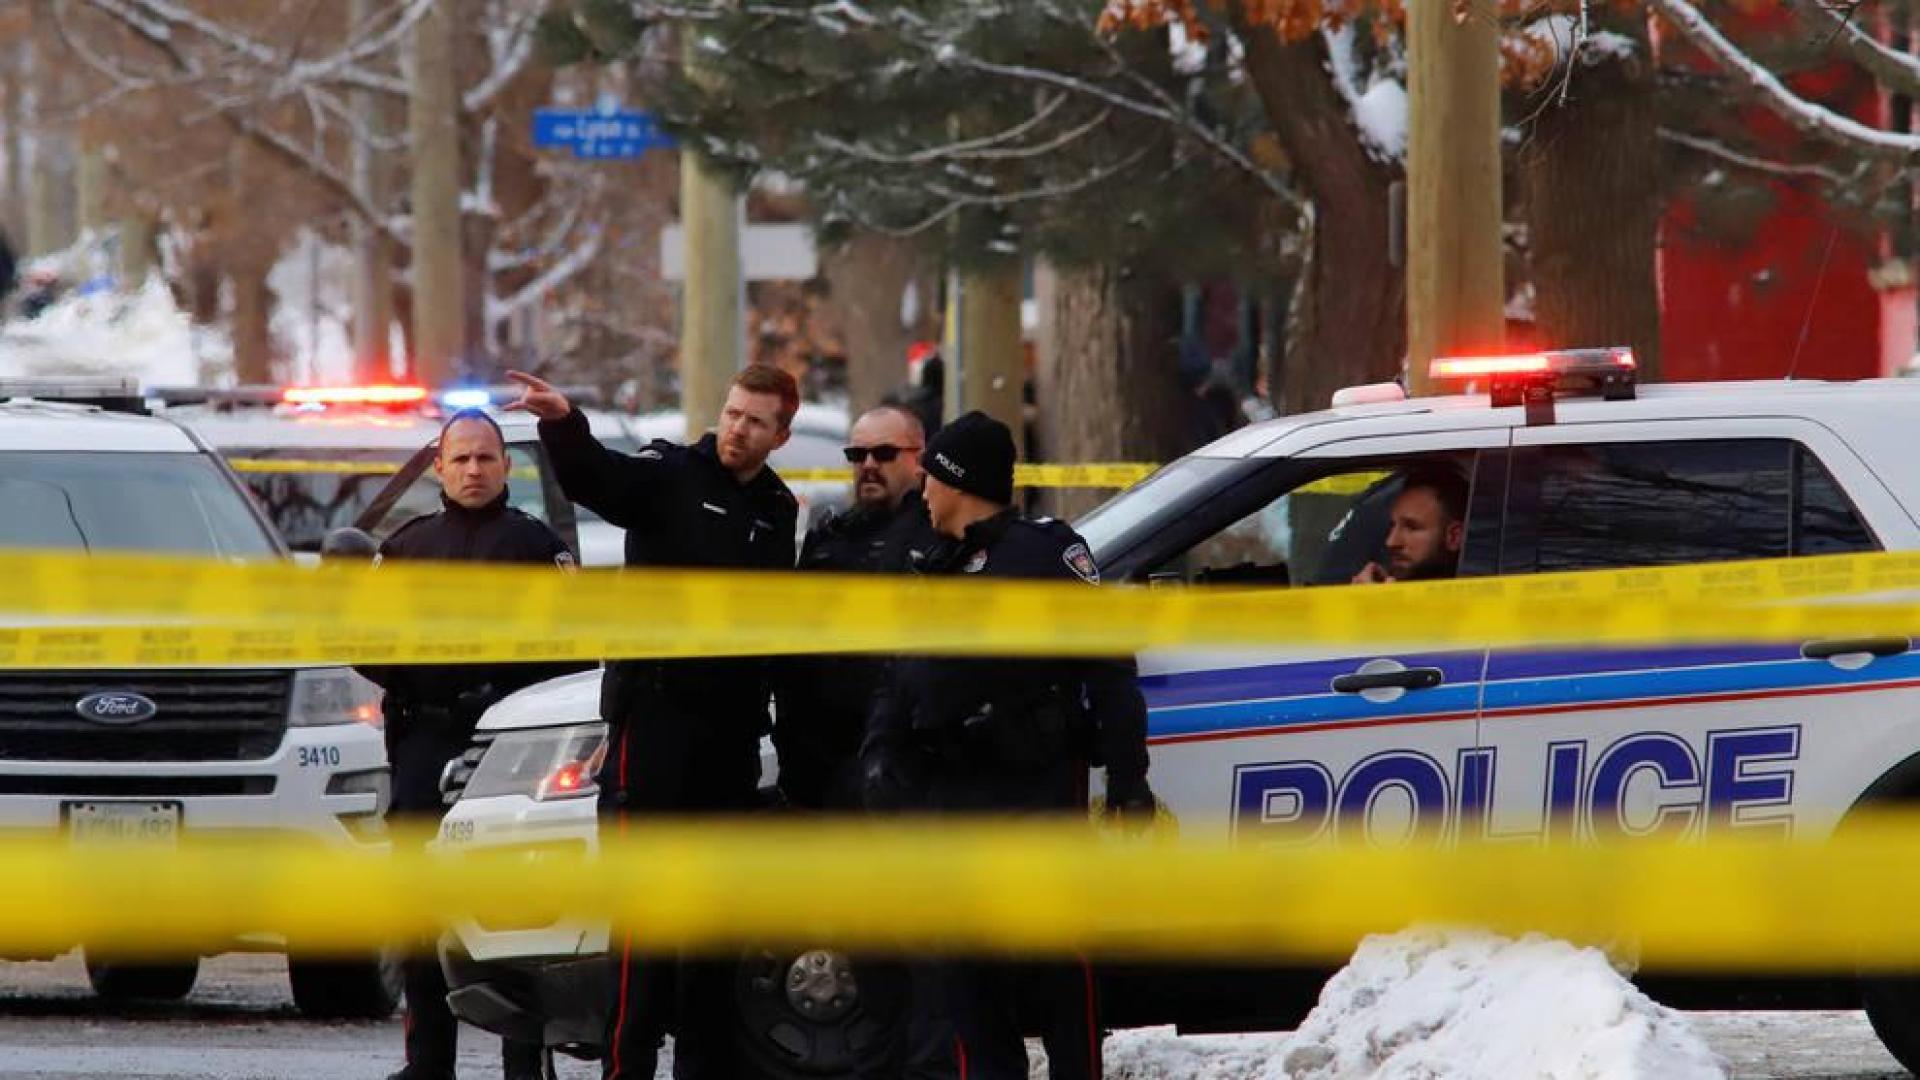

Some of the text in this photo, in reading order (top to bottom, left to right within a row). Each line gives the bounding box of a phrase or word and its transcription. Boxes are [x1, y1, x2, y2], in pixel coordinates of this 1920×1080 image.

[935, 453, 965, 478] POLICE
[297, 745, 341, 767] 3410
[1229, 724, 1802, 850] POLICE
